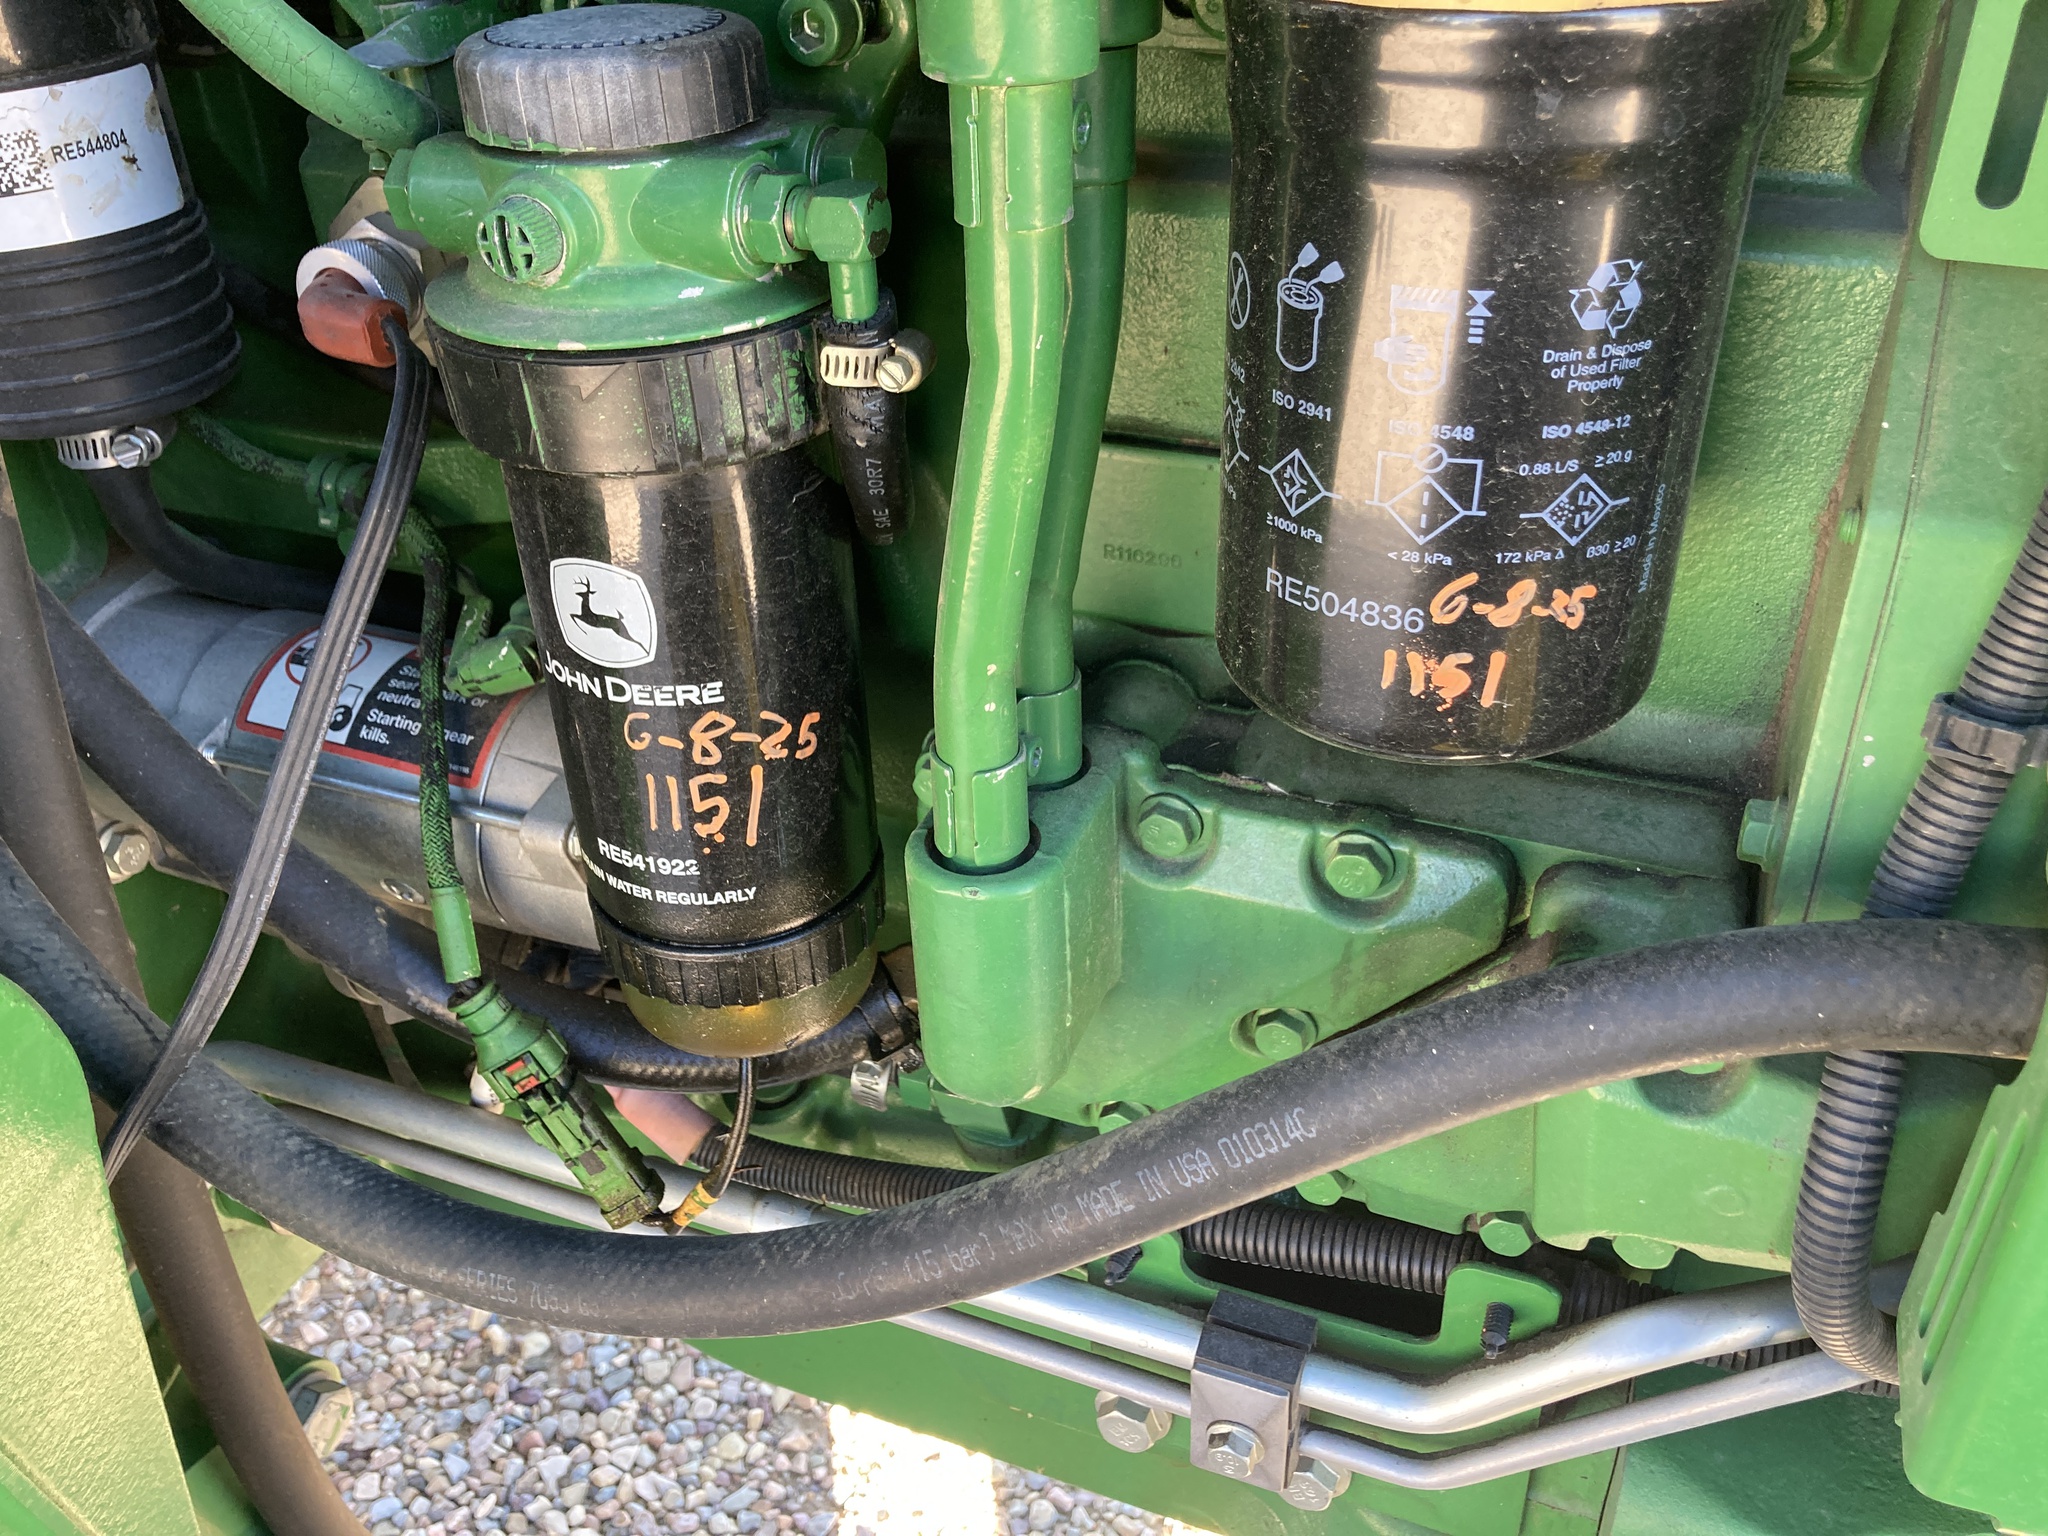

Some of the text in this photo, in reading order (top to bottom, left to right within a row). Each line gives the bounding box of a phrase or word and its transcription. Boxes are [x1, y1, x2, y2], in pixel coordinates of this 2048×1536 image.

[51, 129, 128, 164] RE544804
[1543, 339, 1652, 363] Drain & Dispose
[1551, 356, 1642, 379] of Used Filter
[1567, 374, 1625, 394] Properly
[1272, 389, 1332, 422] ISO 2941
[1389, 419, 1476, 441] ISO 4548
[1541, 414, 1632, 439] ISO 4548-12
[865, 458, 885, 496] 30R7
[1519, 459, 1580, 477] 0.88 L/S
[872, 508, 891, 529] SAE
[1301, 525, 1323, 543] kPa
[1637, 554, 1653, 594] Made
[1648, 483, 1666, 535] Mexico
[1401, 550, 1420, 563] 28
[1424, 552, 1453, 566] kPa
[1495, 552, 1521, 564] 172
[1525, 550, 1551, 563] kPa
[1265, 567, 1425, 634] RE504836
[399, 664, 422, 678] Sta
[545, 651, 725, 706] JOHN DEERE
[1381, 649, 1507, 708] 1151
[377, 690, 422, 709] neutra
[470, 695, 490, 708] or
[359, 724, 391, 745] kills.
[367, 708, 422, 736] Starting
[623, 710, 821, 765] 6-8-25
[282, 787, 308, 848] CONDUCTOR
[303, 759, 317, 781] FOR
[314, 697, 337, 752] GROUNDING
[646, 765, 764, 848] 1151
[597, 837, 701, 876] RE541922
[605, 873, 653, 901] WATER
[655, 887, 757, 906] REGULARLY
[1075, 1180, 1135, 1224] MADE
[1135, 1165, 1172, 1202] IN
[1168, 1147, 1219, 1188] USA
[1217, 1107, 1318, 1169] 010314C
